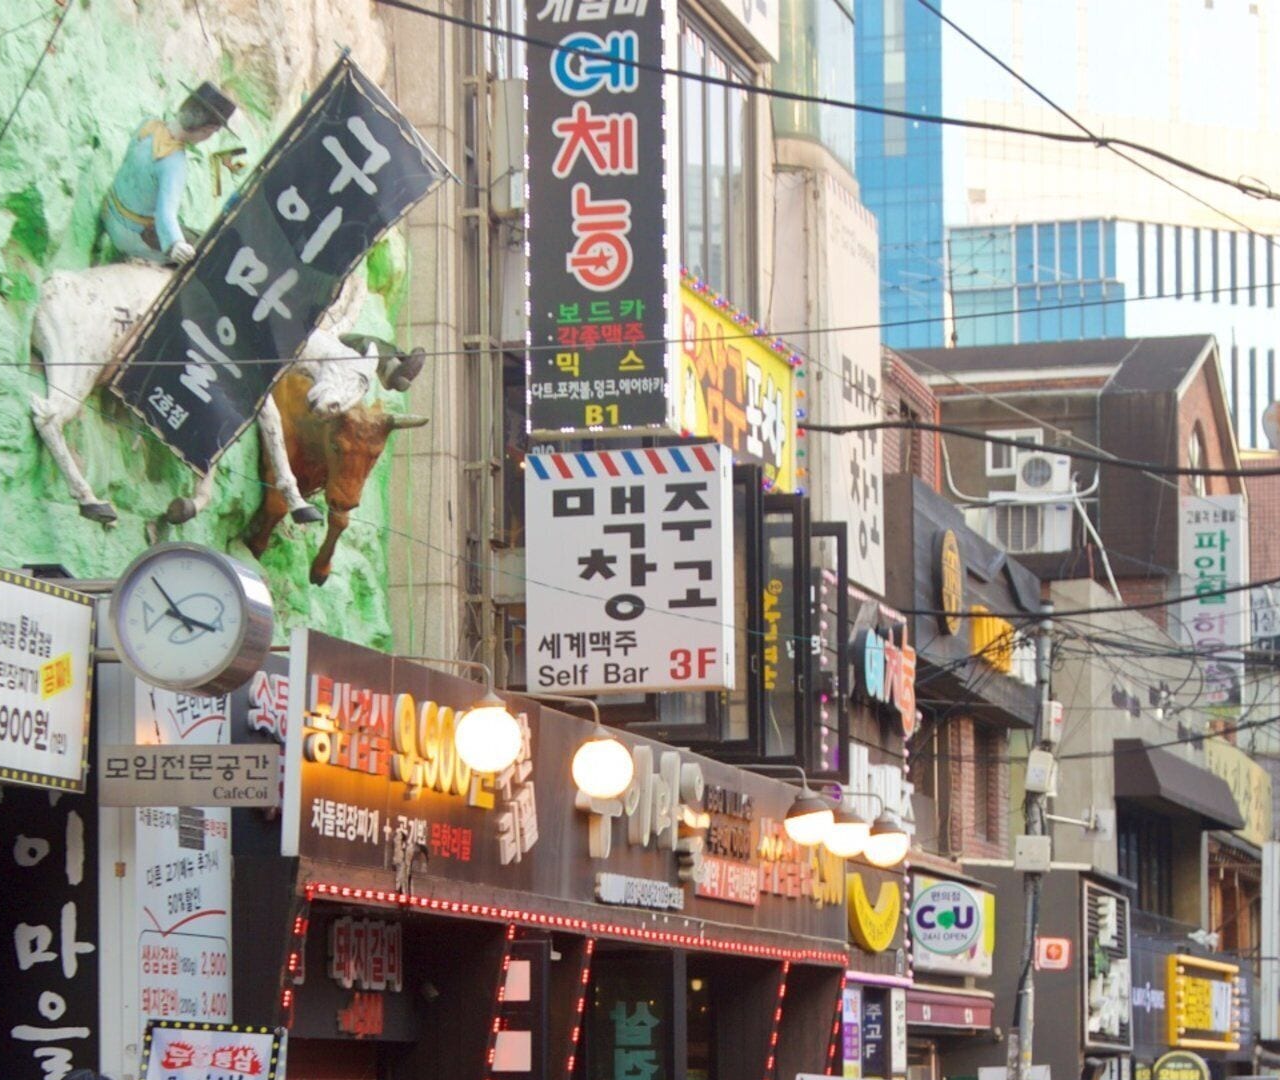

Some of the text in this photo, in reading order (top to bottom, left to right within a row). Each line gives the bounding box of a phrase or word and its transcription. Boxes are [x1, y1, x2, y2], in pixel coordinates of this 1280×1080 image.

[552, 33, 638, 288] 예체능
[557, 299, 646, 324] 보드카
[556, 321, 646, 351] 각종맥주
[147, 386, 190, 430] 2호점
[584, 404, 620, 427] B1
[552, 481, 713, 550] 맥주
[577, 548, 717, 622] 창고
[538, 630, 638, 660] 세계맥주
[538, 662, 650, 687] Self Bar
[669, 647, 717, 681] 3F
[105, 754, 270, 782] 모임전문공간
[212, 786, 269, 800] CafeCoi
[915, 904, 974, 930] CU
